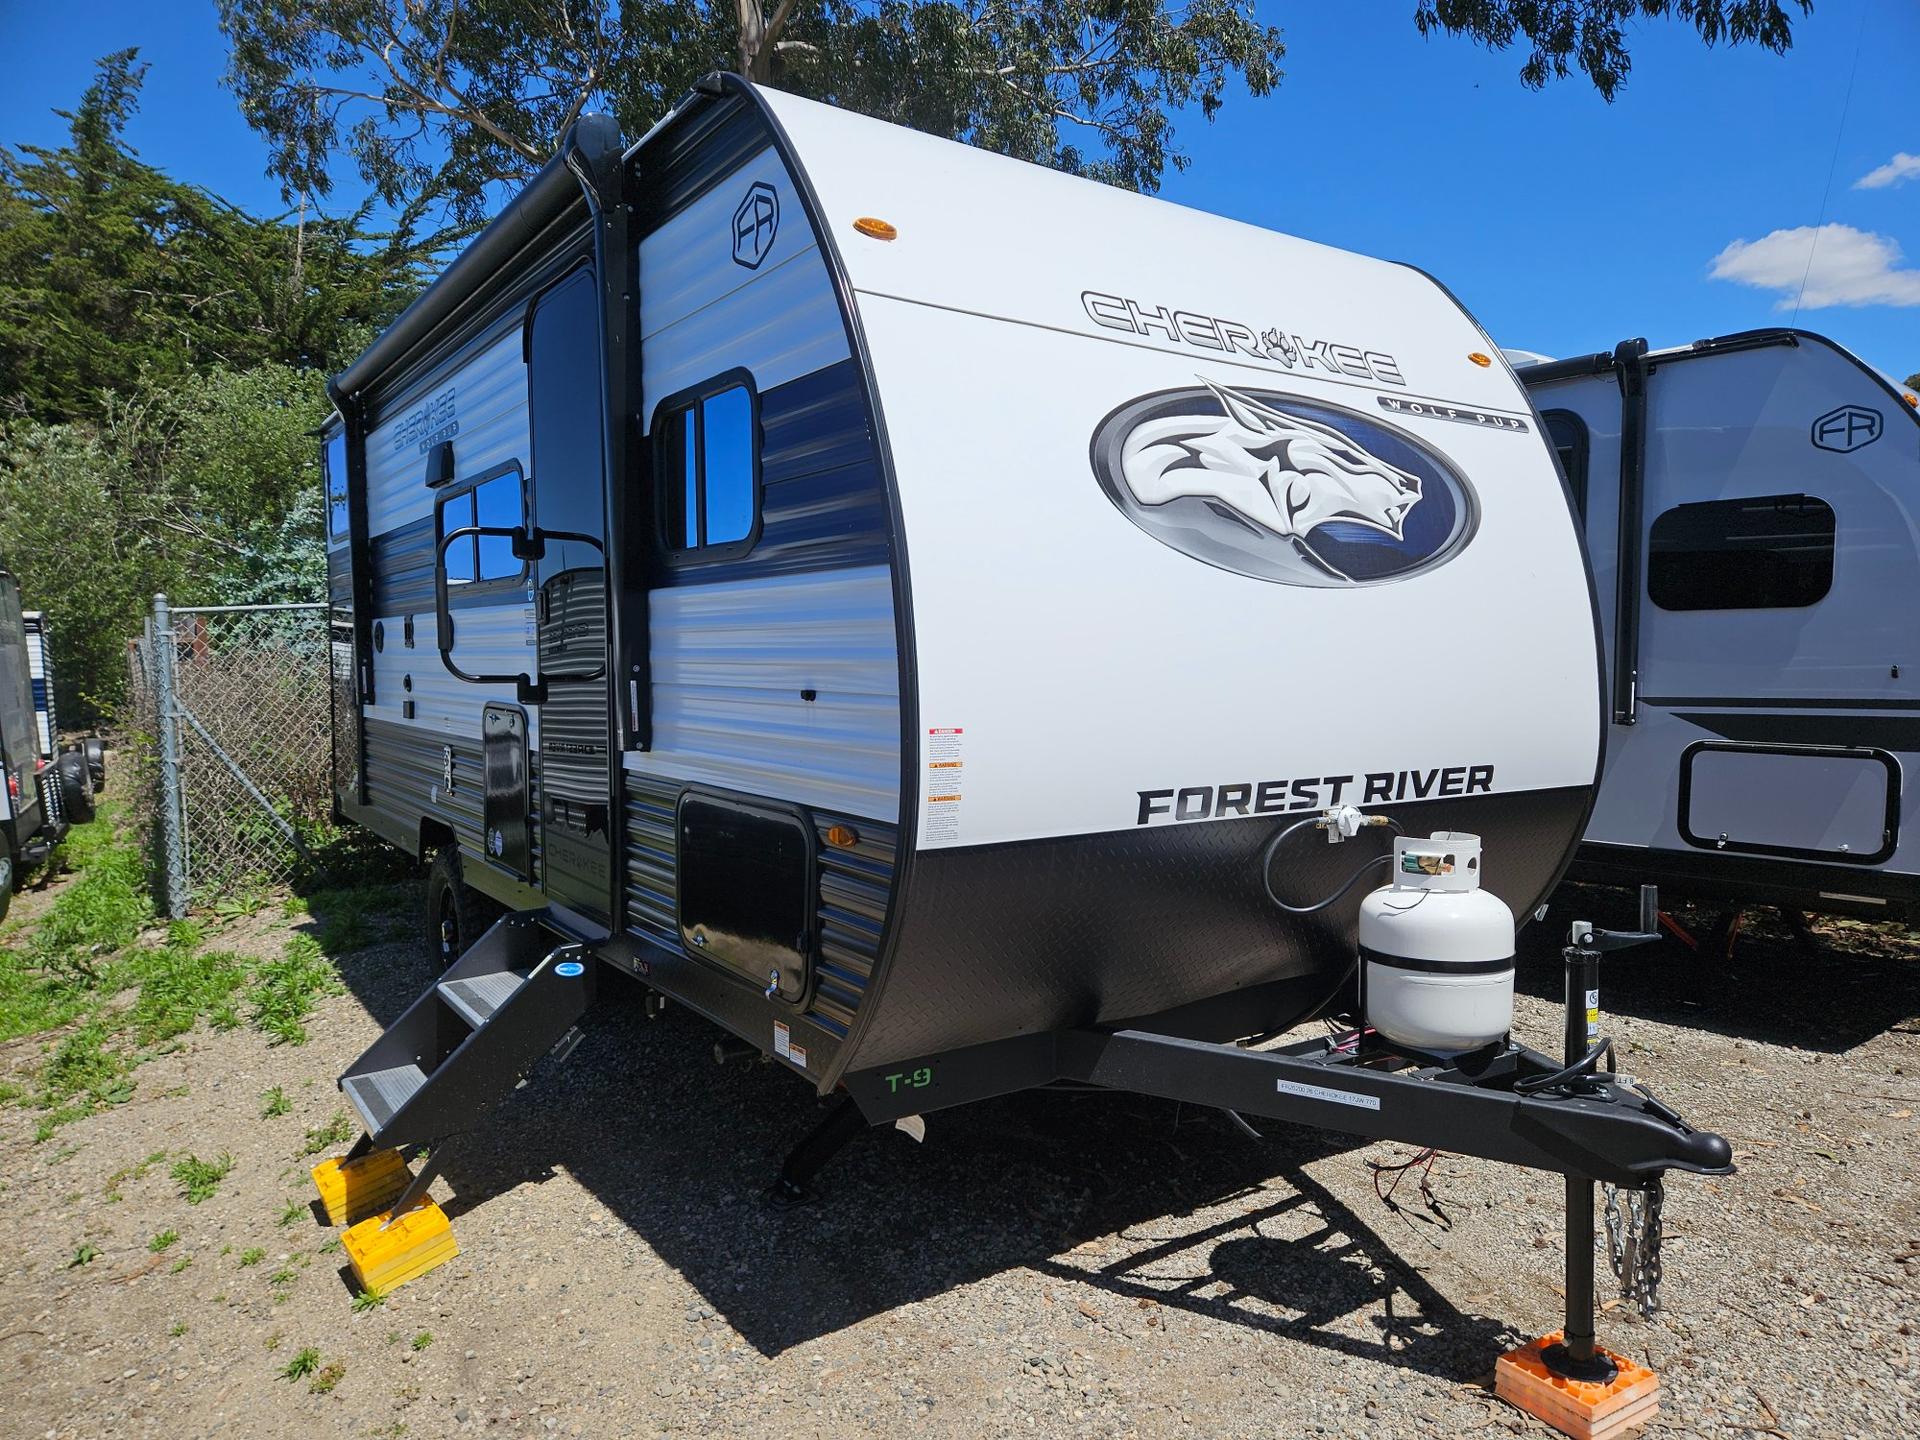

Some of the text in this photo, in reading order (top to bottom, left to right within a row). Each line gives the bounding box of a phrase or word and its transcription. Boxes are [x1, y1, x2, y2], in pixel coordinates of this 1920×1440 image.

[1387, 399, 1520, 429] WOLF PUP
[1136, 764, 1495, 825] FOREST RIVER
[885, 1068, 931, 1092] T-9
